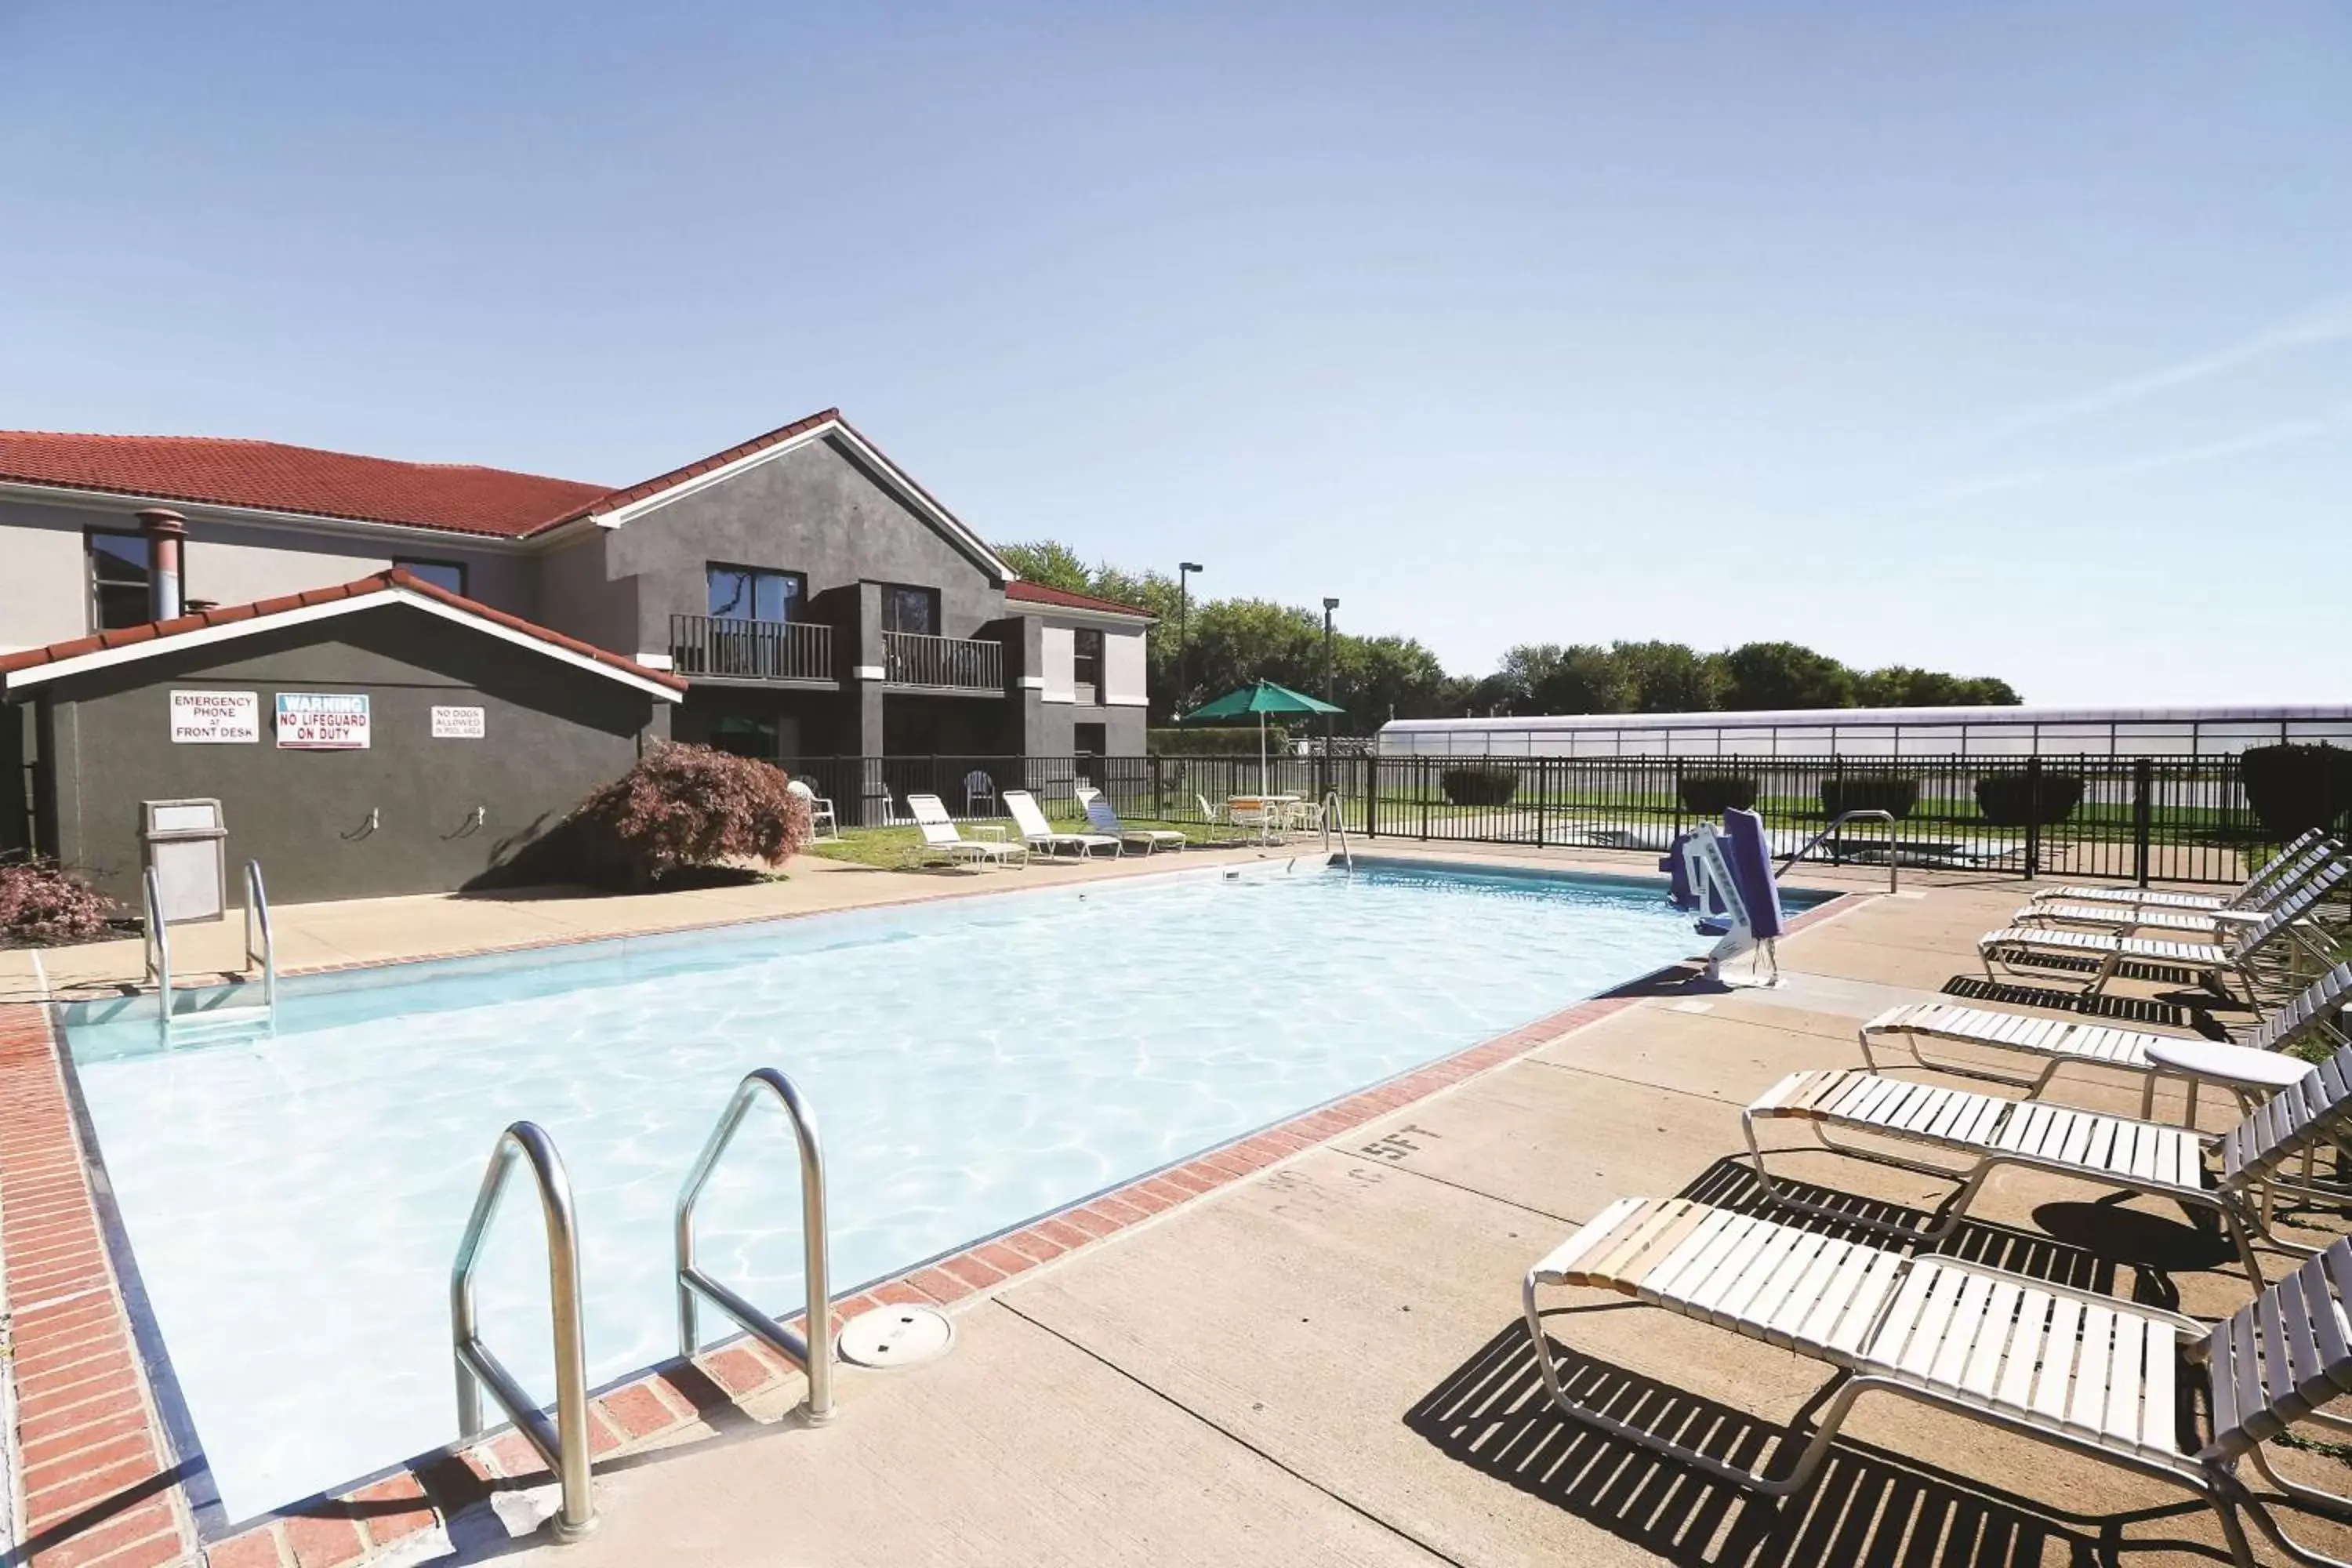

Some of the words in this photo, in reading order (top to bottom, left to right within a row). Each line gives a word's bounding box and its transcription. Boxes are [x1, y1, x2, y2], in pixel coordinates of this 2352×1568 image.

[175, 695, 252, 706] EMERGENCY
[285, 695, 363, 713] WARNING
[194, 707, 236, 717] PHONE
[280, 713, 297, 726] NO
[303, 714, 367, 727] LIFEGUARD
[176, 727, 217, 738] FRONT
[220, 728, 252, 738] DESK
[297, 727, 314, 739] ON
[319, 728, 350, 739] DUTY
[1360, 1123, 1442, 1161] 5FT
